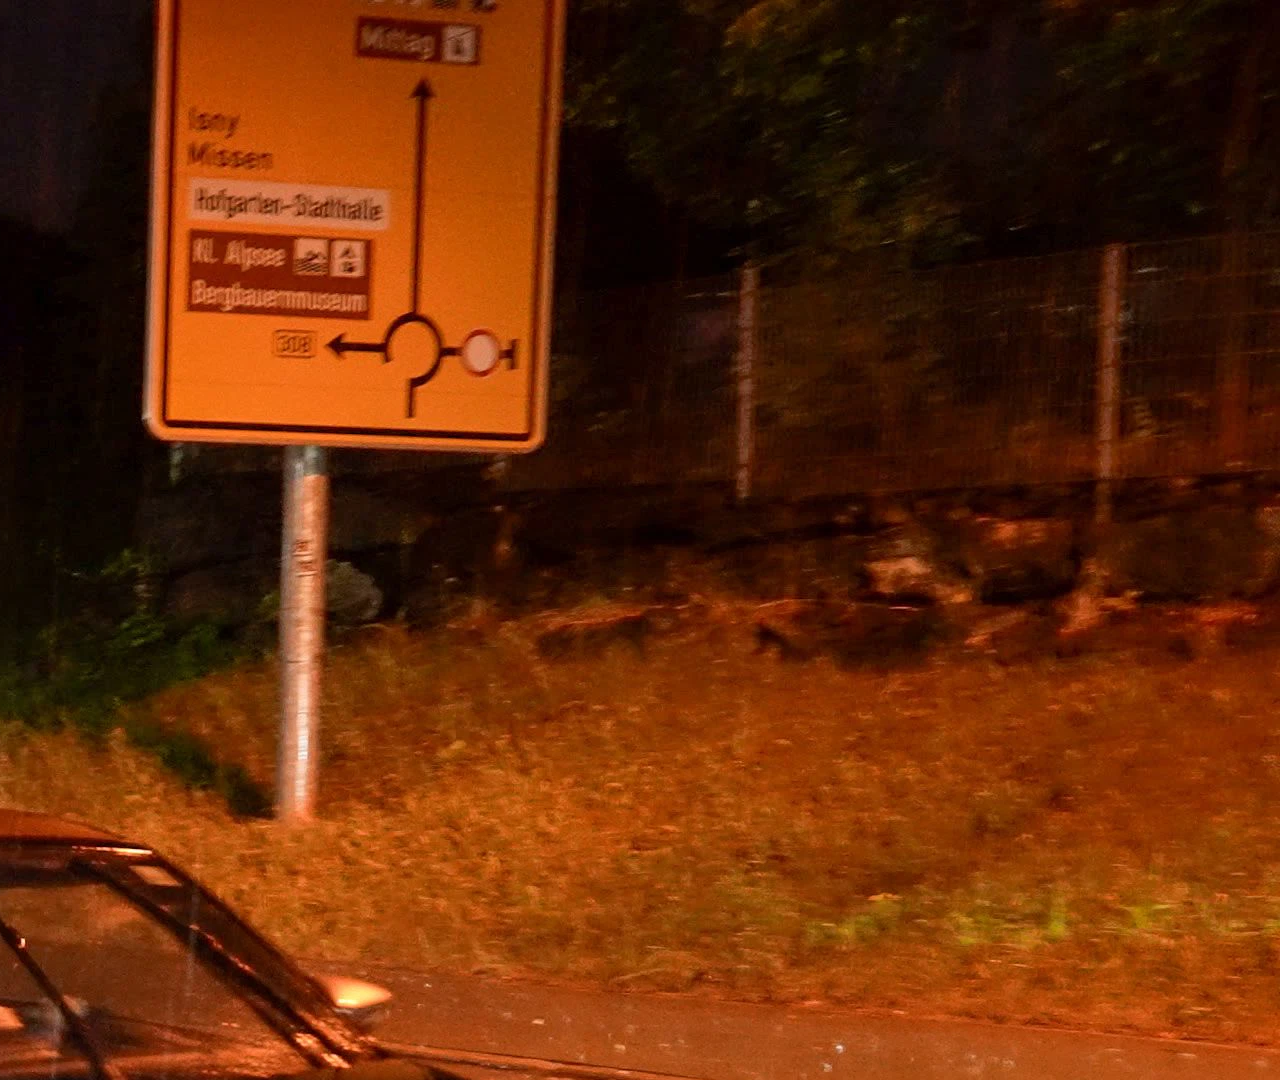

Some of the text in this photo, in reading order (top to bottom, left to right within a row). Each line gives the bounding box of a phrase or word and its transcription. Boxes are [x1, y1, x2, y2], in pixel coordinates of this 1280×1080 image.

[361, 24, 435, 60] Mittag
[188, 107, 239, 138] Isny
[187, 142, 273, 171] Missen
[224, 239, 286, 271] Alpsee
[192, 279, 367, 312] Bergbauernmuseum
[278, 335, 311, 352] 308
